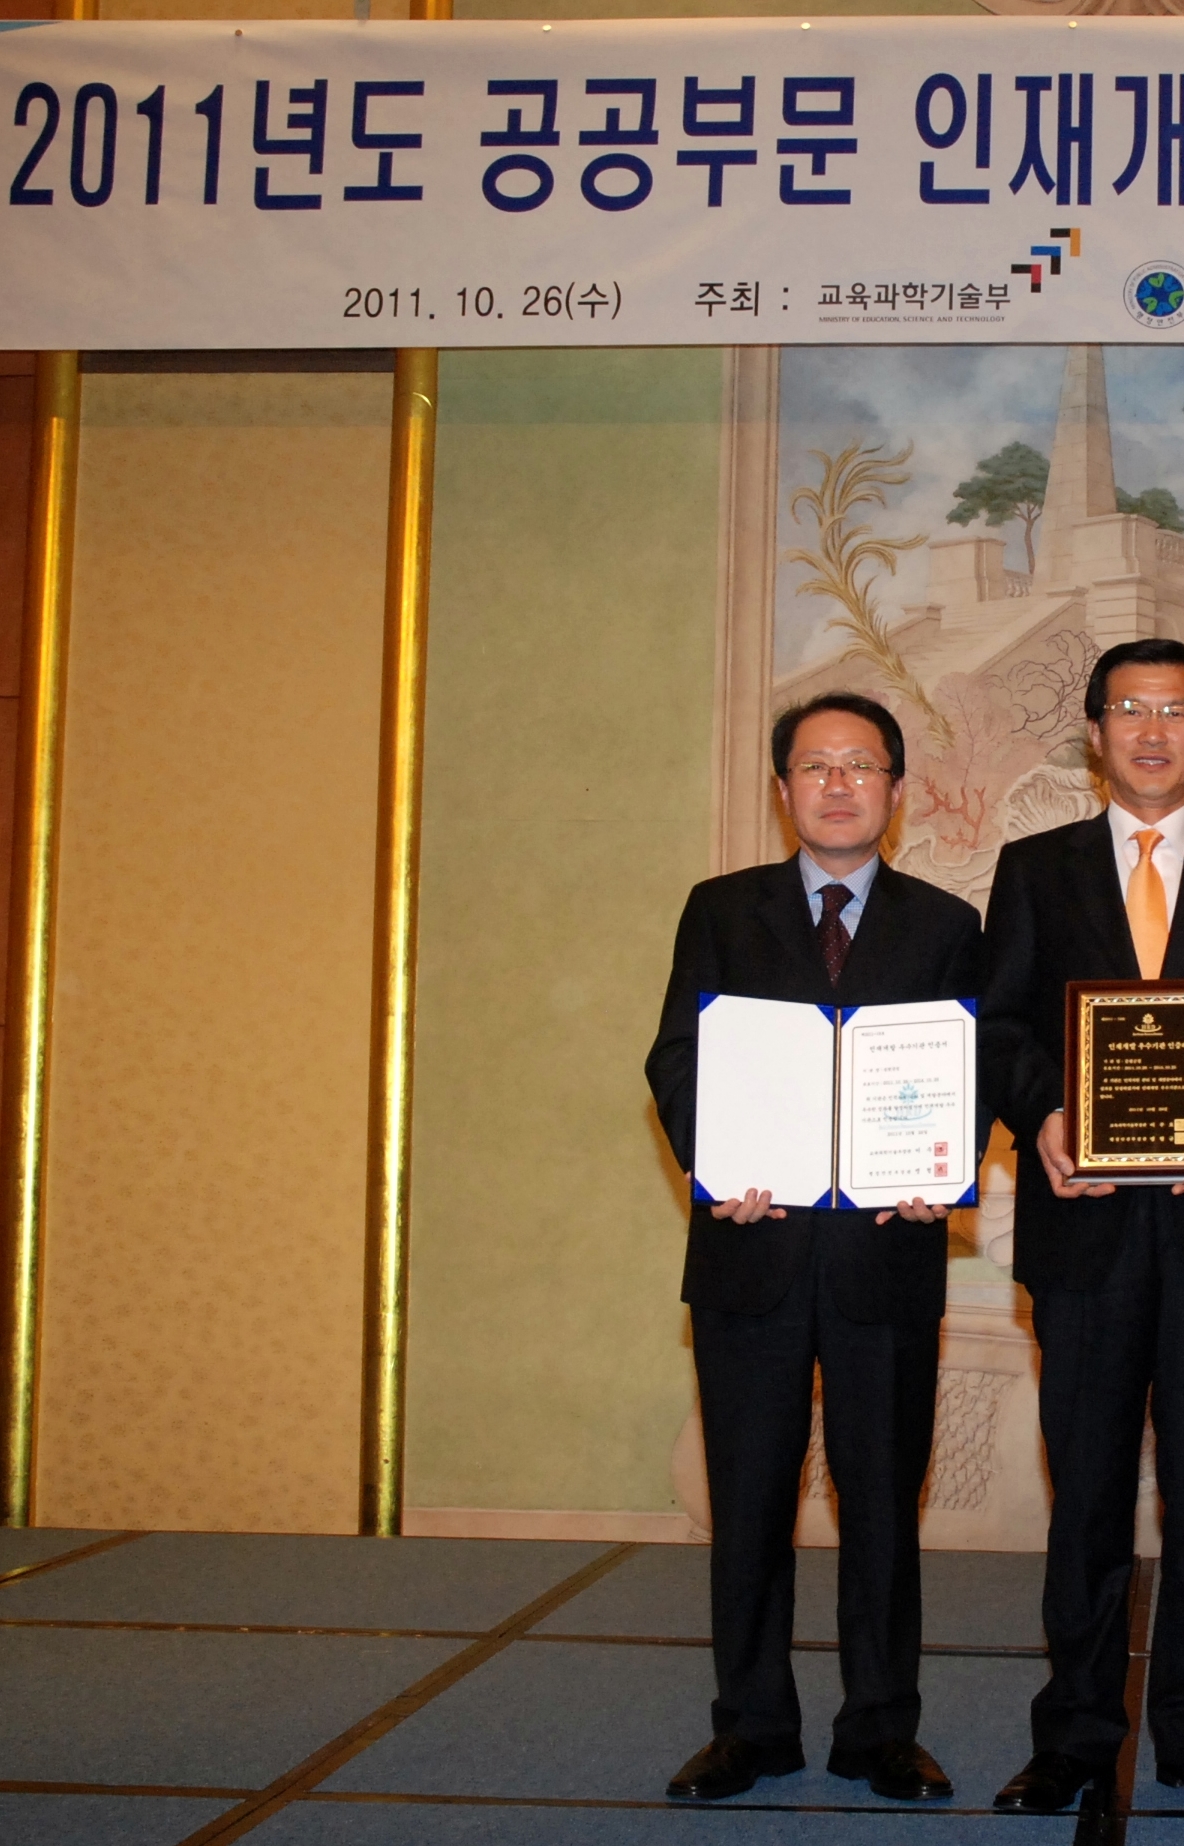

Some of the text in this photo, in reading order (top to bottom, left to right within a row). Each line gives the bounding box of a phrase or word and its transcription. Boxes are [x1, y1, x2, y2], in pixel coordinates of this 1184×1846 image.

[9, 78, 425, 211] 2011년도
[479, 75, 858, 213] 공공부문
[343, 281, 622, 320] 2011. 10. 26(수)
[694, 280, 760, 318] 주최
[817, 281, 1011, 311] 교육과학기술부
